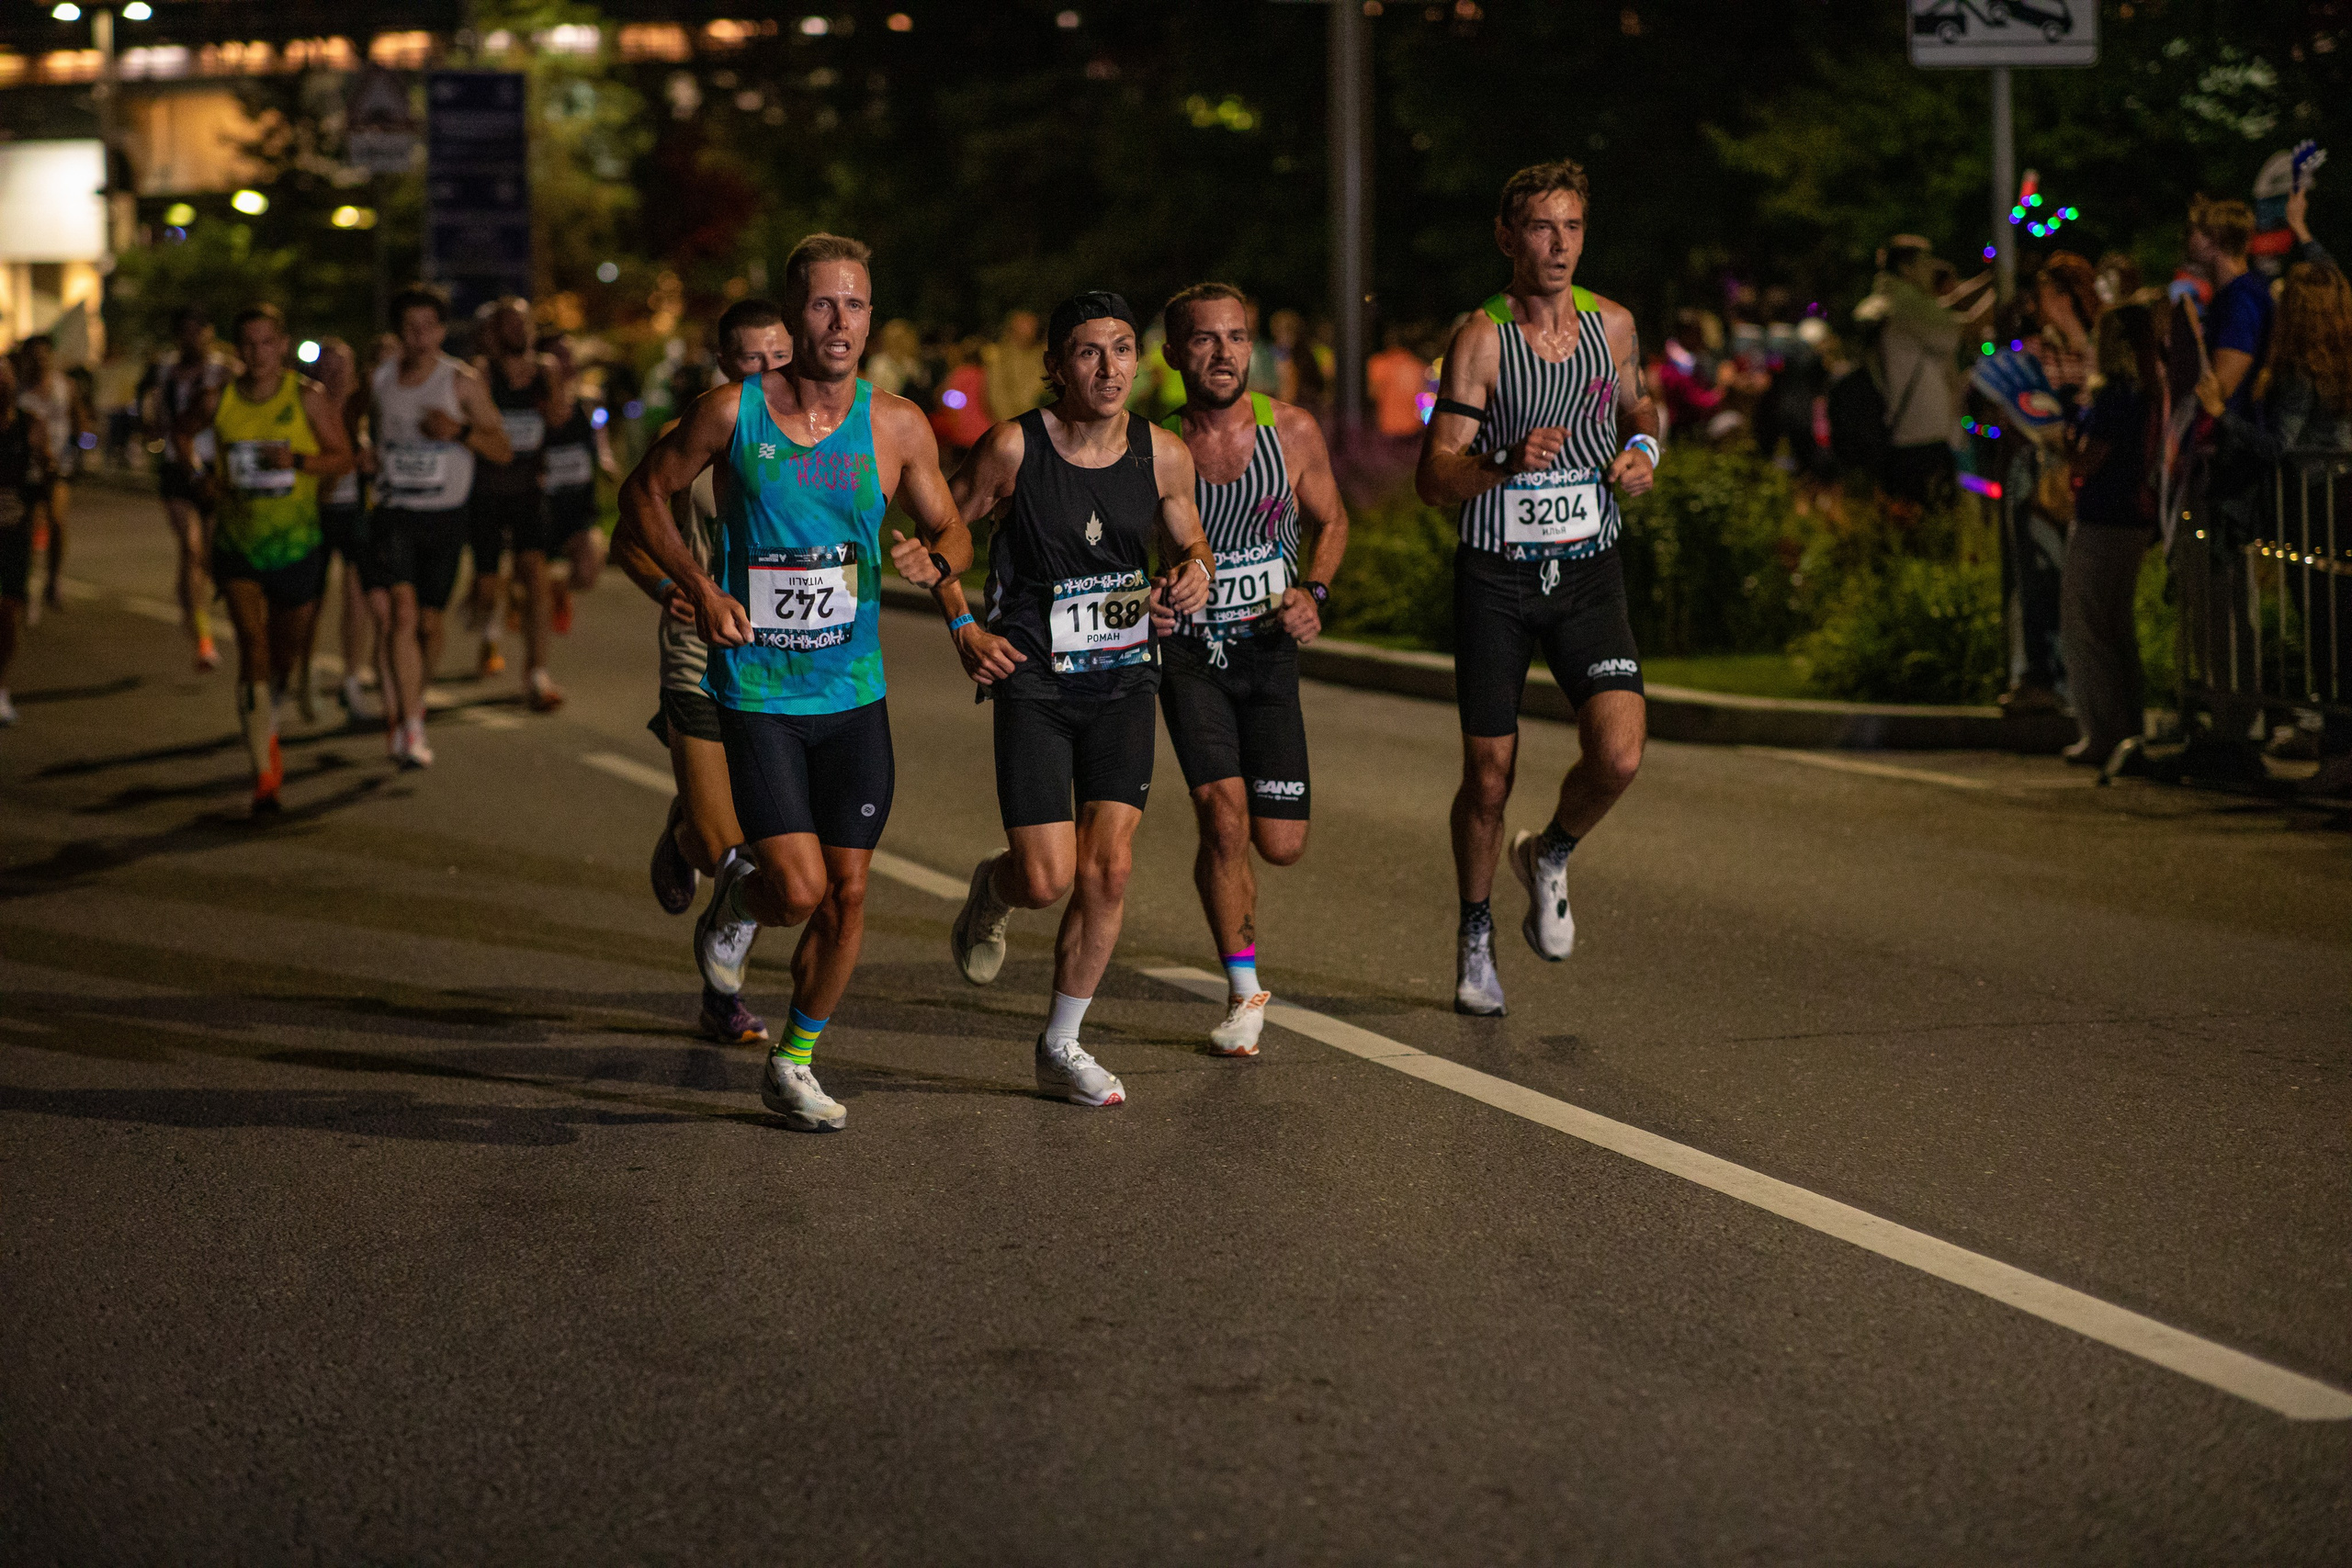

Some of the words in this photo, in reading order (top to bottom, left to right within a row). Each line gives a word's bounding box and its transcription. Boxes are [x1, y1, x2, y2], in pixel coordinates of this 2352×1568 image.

[796, 468, 861, 491] HOUSE
[1518, 493, 1588, 525] 3204
[1214, 543, 1273, 566] ОЧНОЙ
[789, 577, 823, 586] VITALII
[775, 587, 834, 621] 242
[1067, 600, 1141, 633] 1188
[1087, 633, 1120, 643] РОМАН
[1587, 659, 1638, 678] GANG
[1252, 779, 1306, 796] GANG
